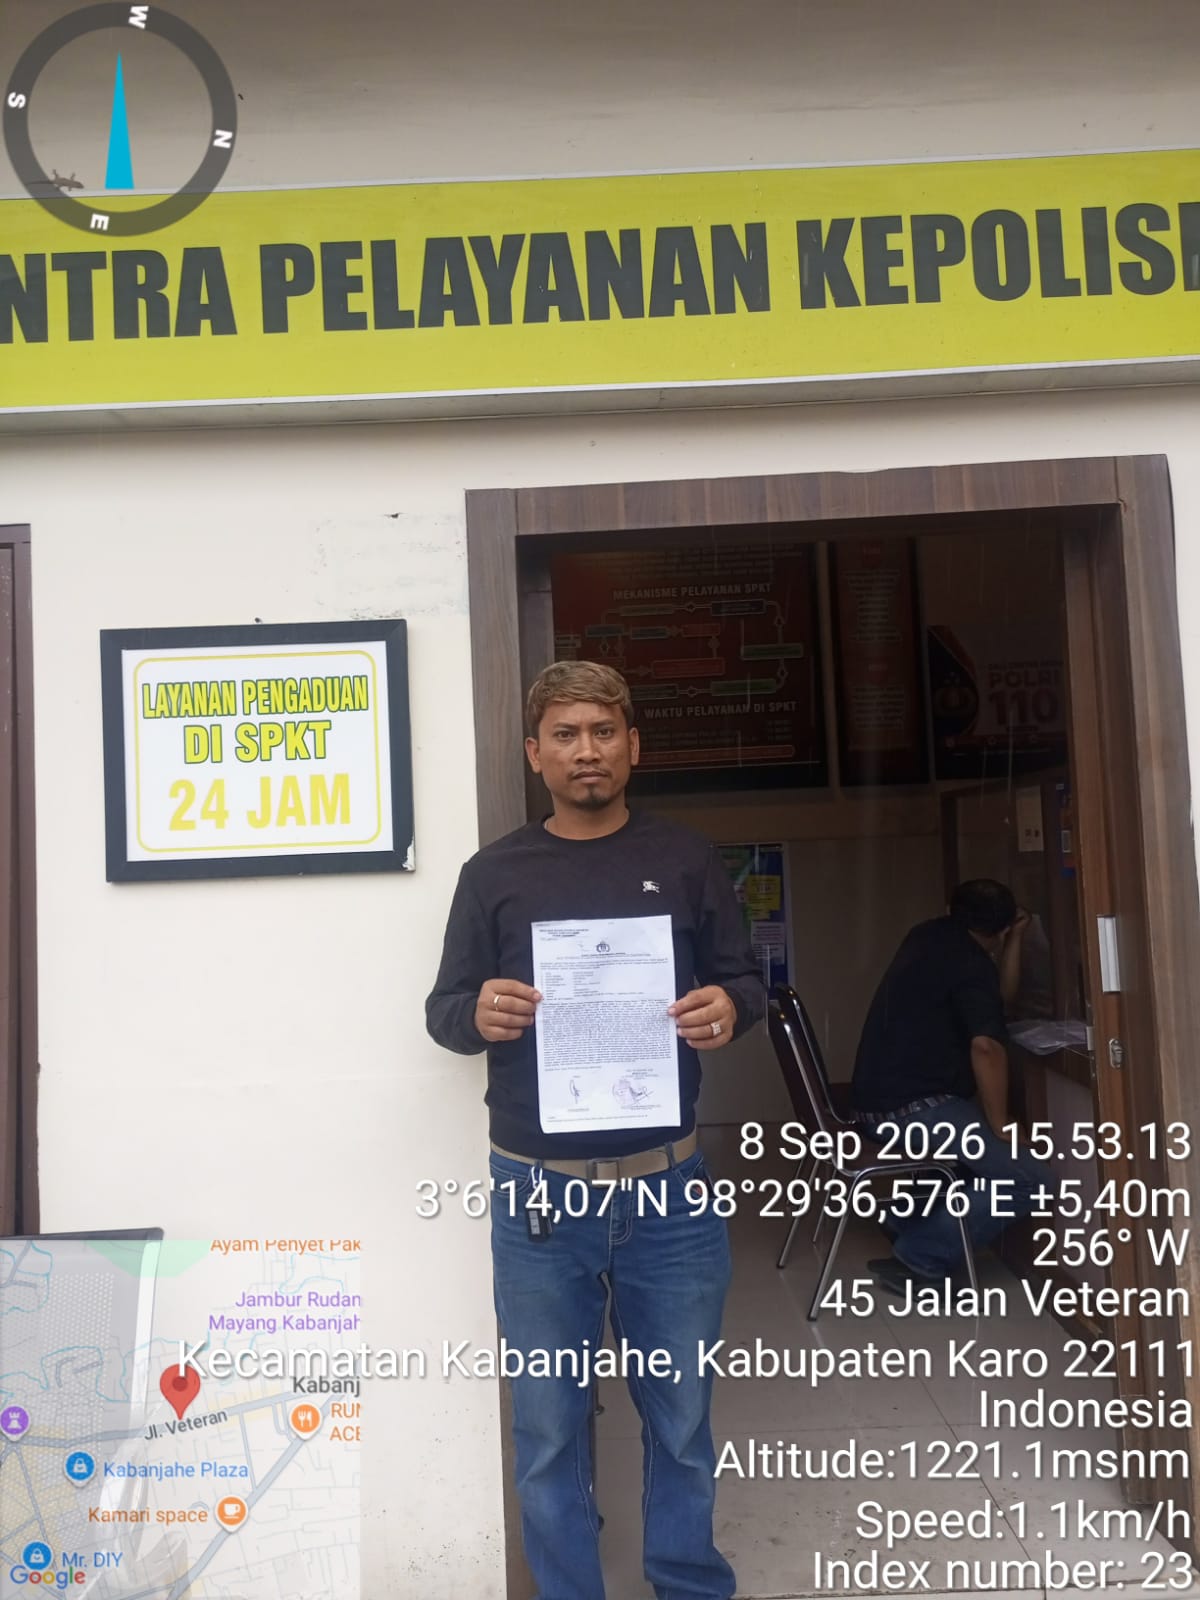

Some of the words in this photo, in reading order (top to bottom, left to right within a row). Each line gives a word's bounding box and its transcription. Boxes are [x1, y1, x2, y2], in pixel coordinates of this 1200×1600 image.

[0, 247, 237, 344] NTRA
[260, 222, 770, 334] PELAYANAN
[613, 587, 677, 601] MEKANISME
[681, 584, 741, 598] PELAYANAN
[744, 583, 771, 594] SPKT
[142, 681, 236, 718] LAYANAN
[242, 675, 368, 715] PENGADUAN
[643, 707, 683, 719] WAKTU
[687, 703, 750, 717] PELAYANAN
[754, 703, 765, 713] DI
[769, 701, 797, 712] SPKT
[989, 688, 1057, 724] 110
[183, 724, 223, 764] DI
[234, 720, 331, 763] SPKT
[168, 779, 229, 831] 24
[246, 773, 351, 829] JAM
